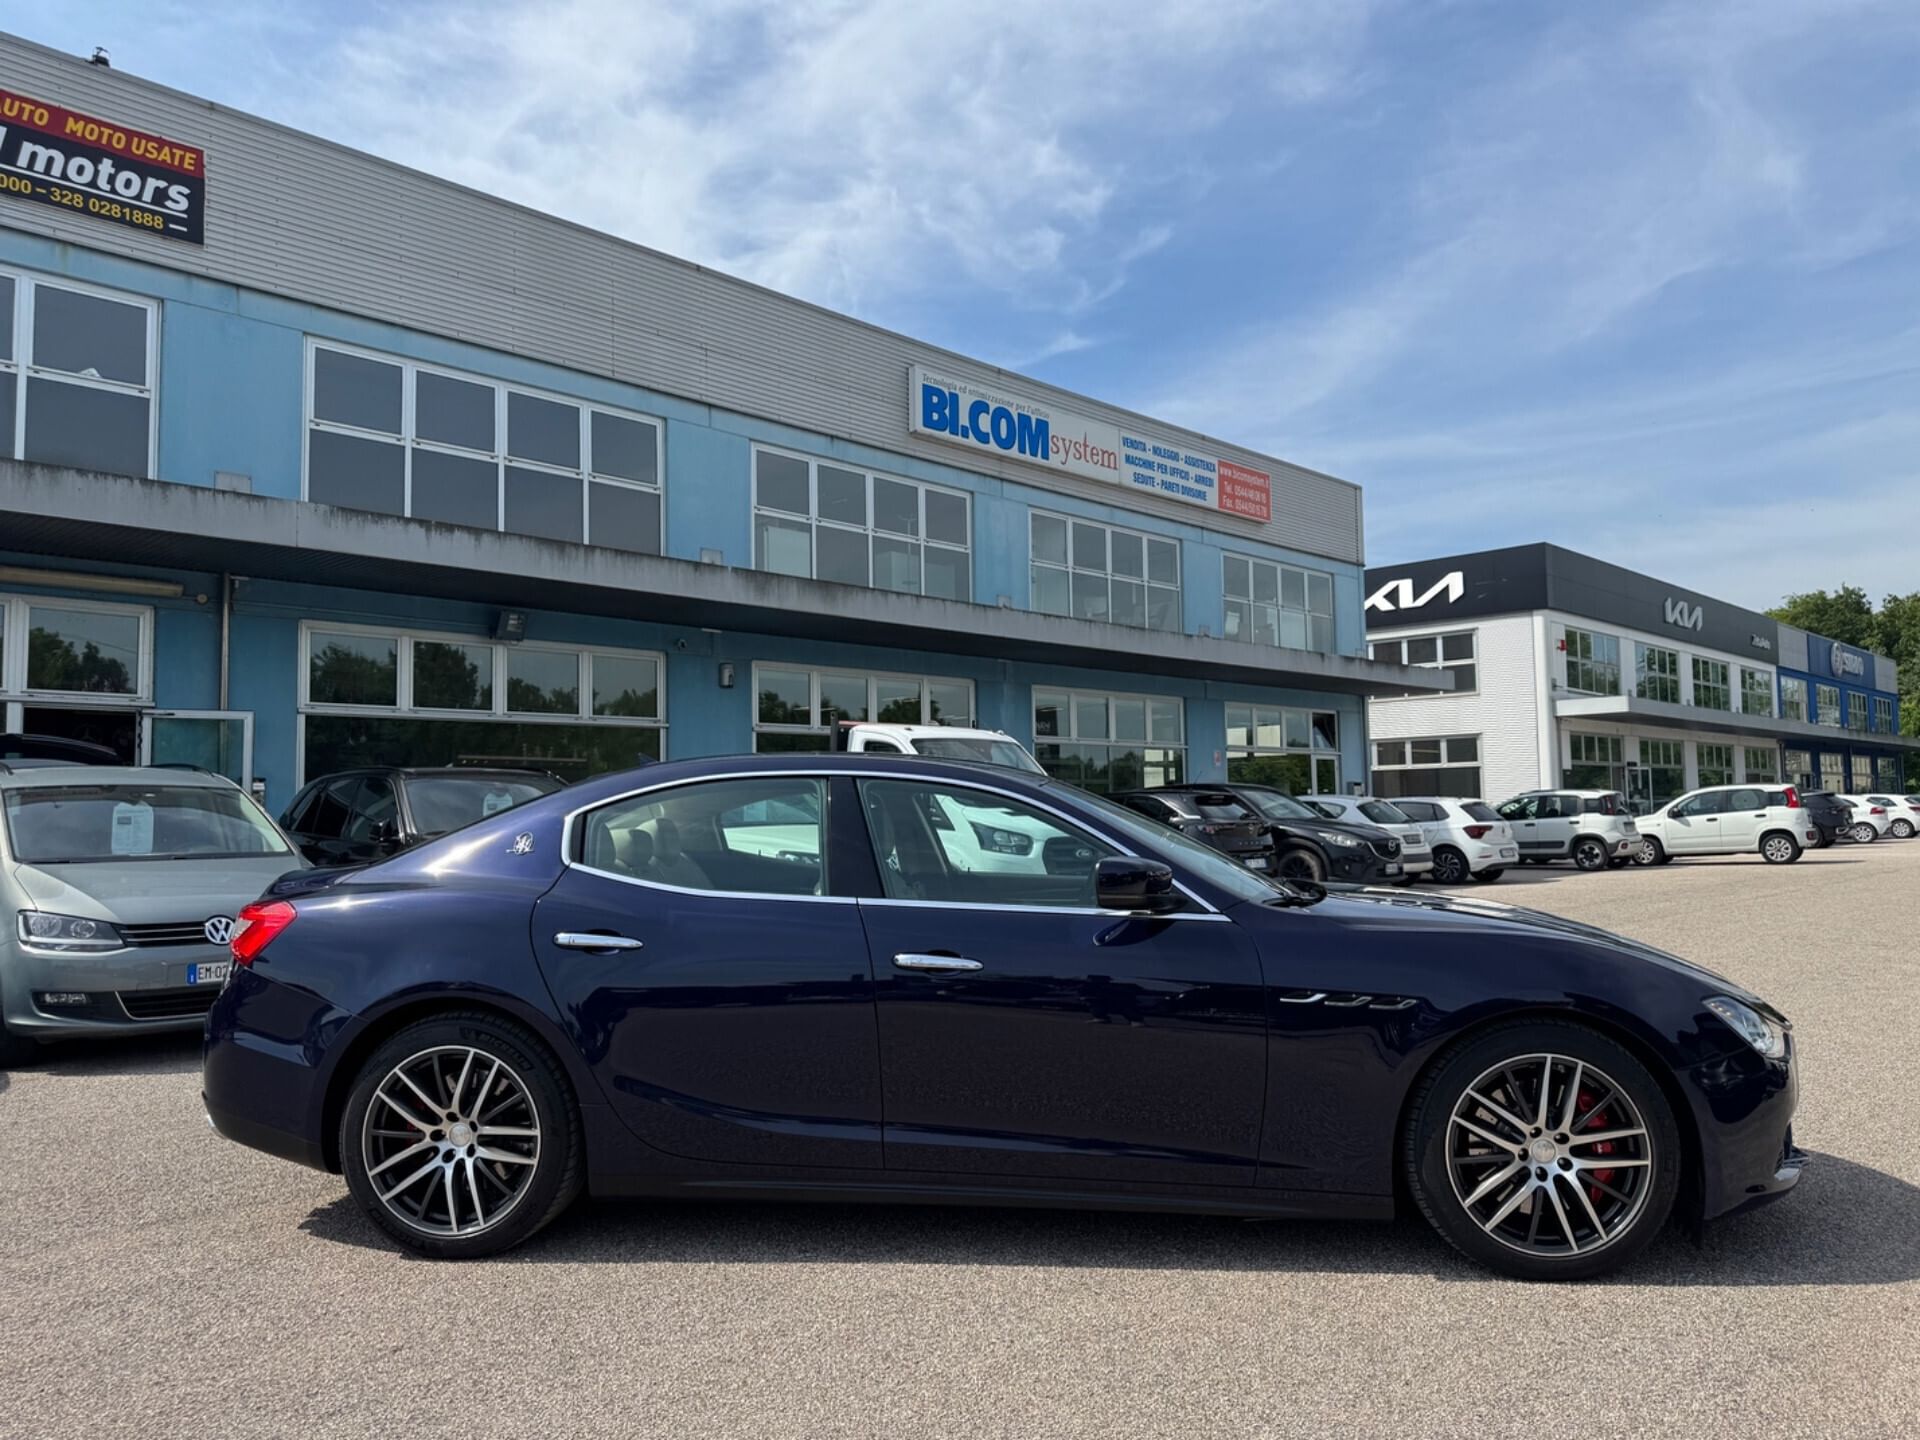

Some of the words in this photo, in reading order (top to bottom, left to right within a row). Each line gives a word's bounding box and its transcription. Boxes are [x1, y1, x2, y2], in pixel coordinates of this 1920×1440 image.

[0, 97, 49, 126] UTO
[64, 117, 126, 149] MOTO
[131, 136, 197, 170] USATE
[16, 141, 191, 211] motors
[50, 187, 84, 208] 328
[88, 198, 164, 229] 0281888
[921, 383, 1050, 461] BI.COM
[1050, 431, 1118, 470] system
[1122, 436, 1147, 452] VENDITA
[1152, 445, 1180, 462] NOLEGGIO
[1184, 455, 1216, 473] ASSISTENZA
[1125, 453, 1156, 471] MACCHINE
[1157, 462, 1168, 475] PER
[1169, 466, 1190, 481] UFFICIO
[1133, 471, 1156, 488] SEDUTE
[1160, 479, 1180, 494] PARETI
[1181, 485, 1208, 501] DIVISORIE
[1364, 571, 1464, 611] KIA
[1664, 597, 1703, 632] KIA
